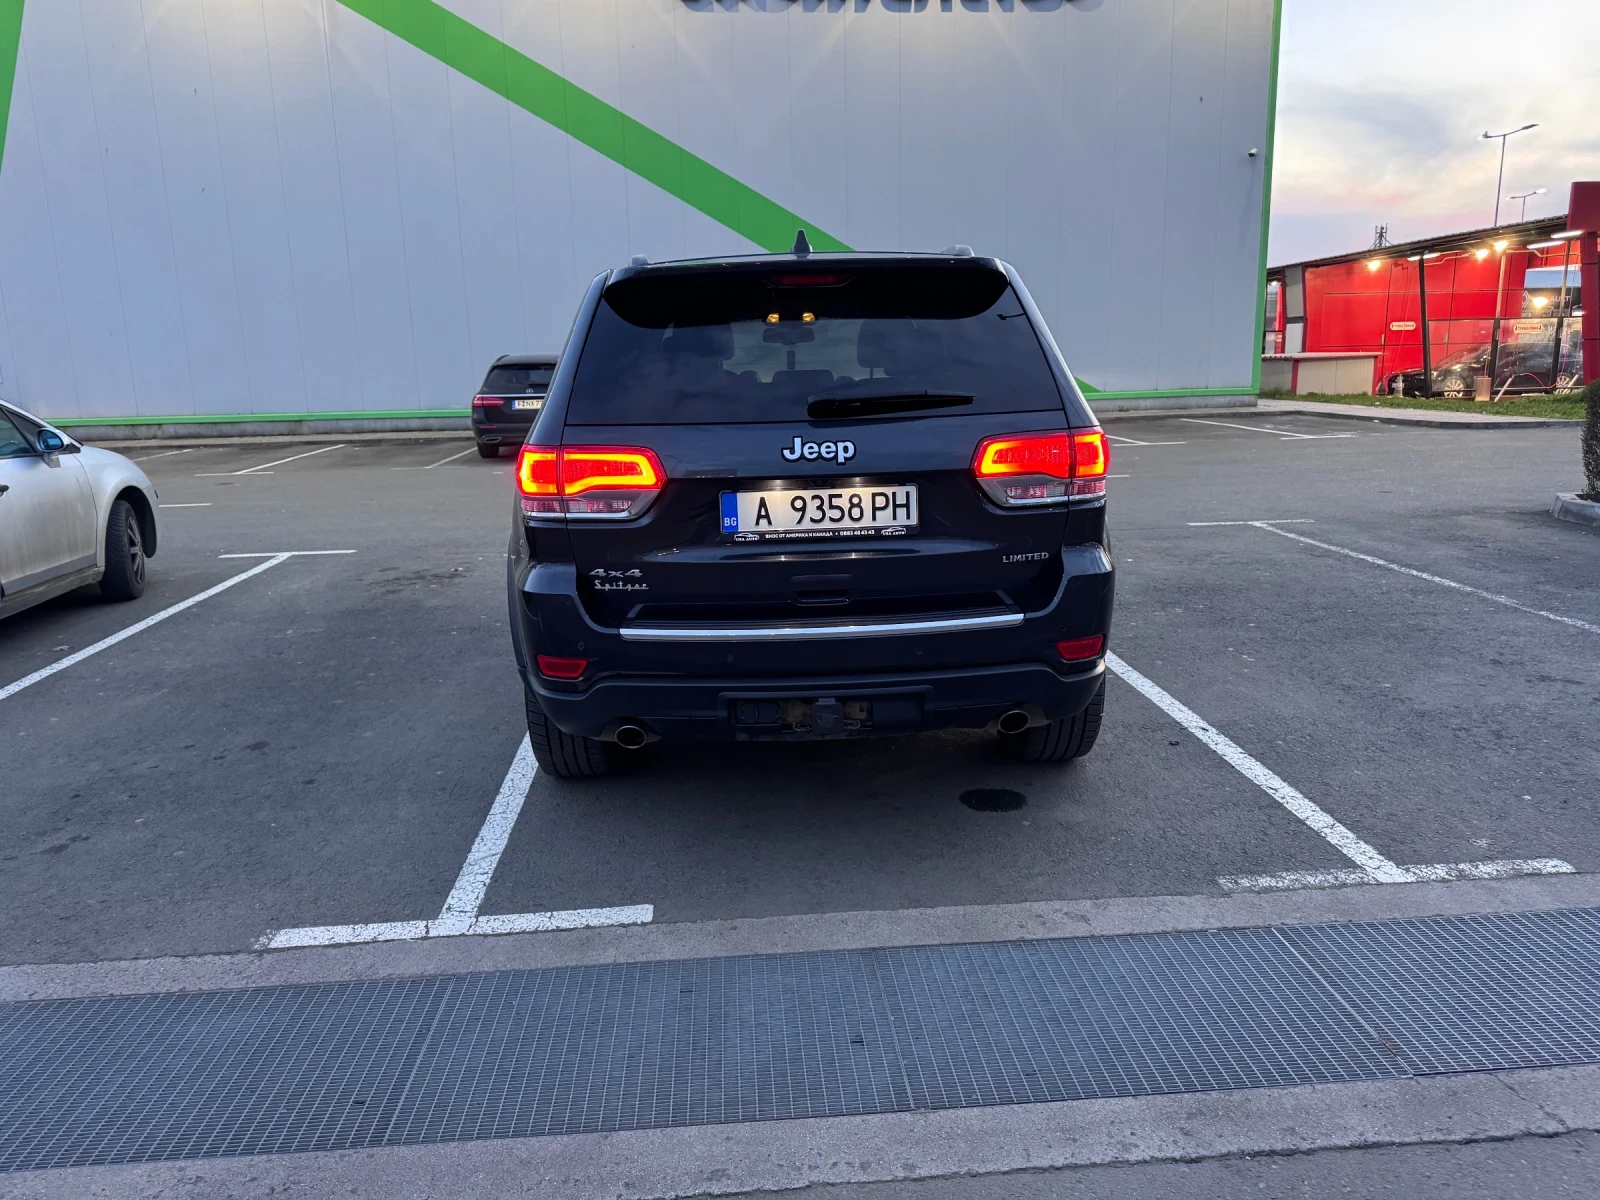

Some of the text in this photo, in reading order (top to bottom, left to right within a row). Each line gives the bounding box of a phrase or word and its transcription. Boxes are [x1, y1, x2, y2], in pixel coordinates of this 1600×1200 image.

[782, 437, 855, 464] Jeep
[755, 490, 911, 526] A 9358 PH
[724, 517, 737, 527] BG
[1002, 552, 1050, 563] LIMITED
[588, 568, 643, 578] 4x4
